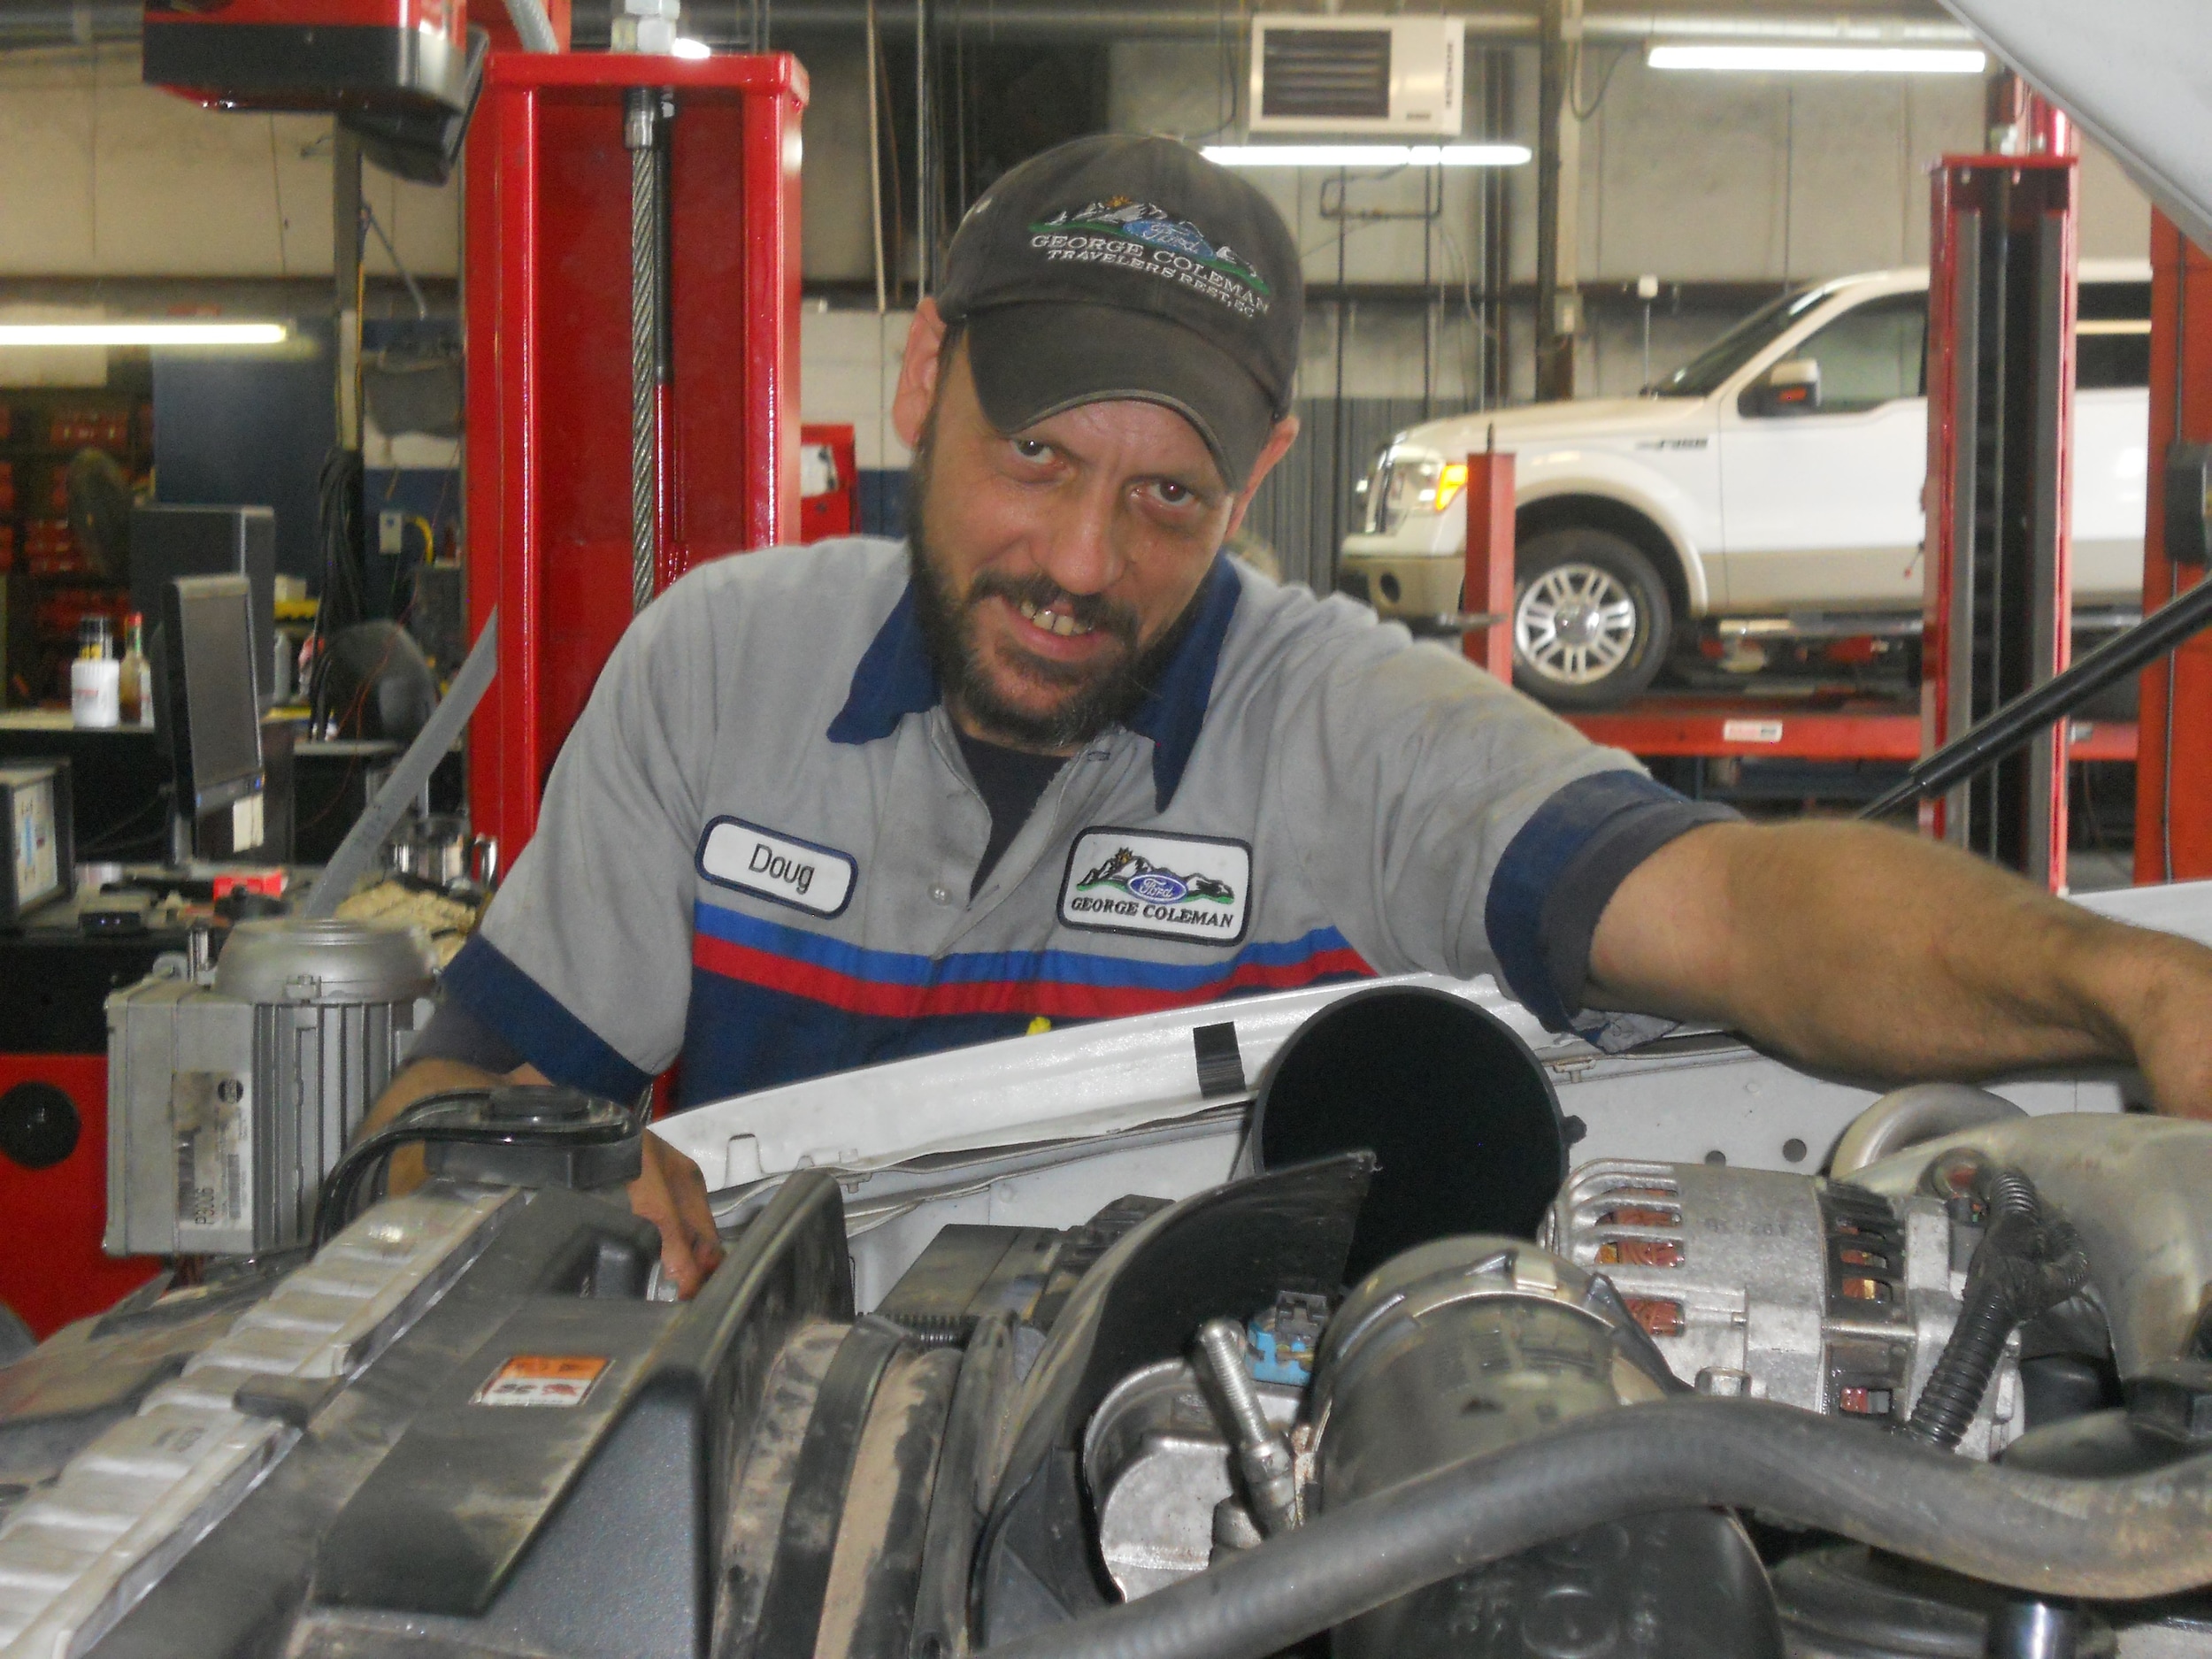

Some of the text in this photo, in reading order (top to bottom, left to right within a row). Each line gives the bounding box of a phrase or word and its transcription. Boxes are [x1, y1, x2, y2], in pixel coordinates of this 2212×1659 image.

[1032, 234, 1270, 315] GEORGE COLEMAN
[1048, 250, 1176, 279] TRAVELERS
[749, 842, 815, 895] Doug
[1139, 878, 1174, 899] Ford
[1071, 896, 1234, 928] GEORGE COLEMAN
